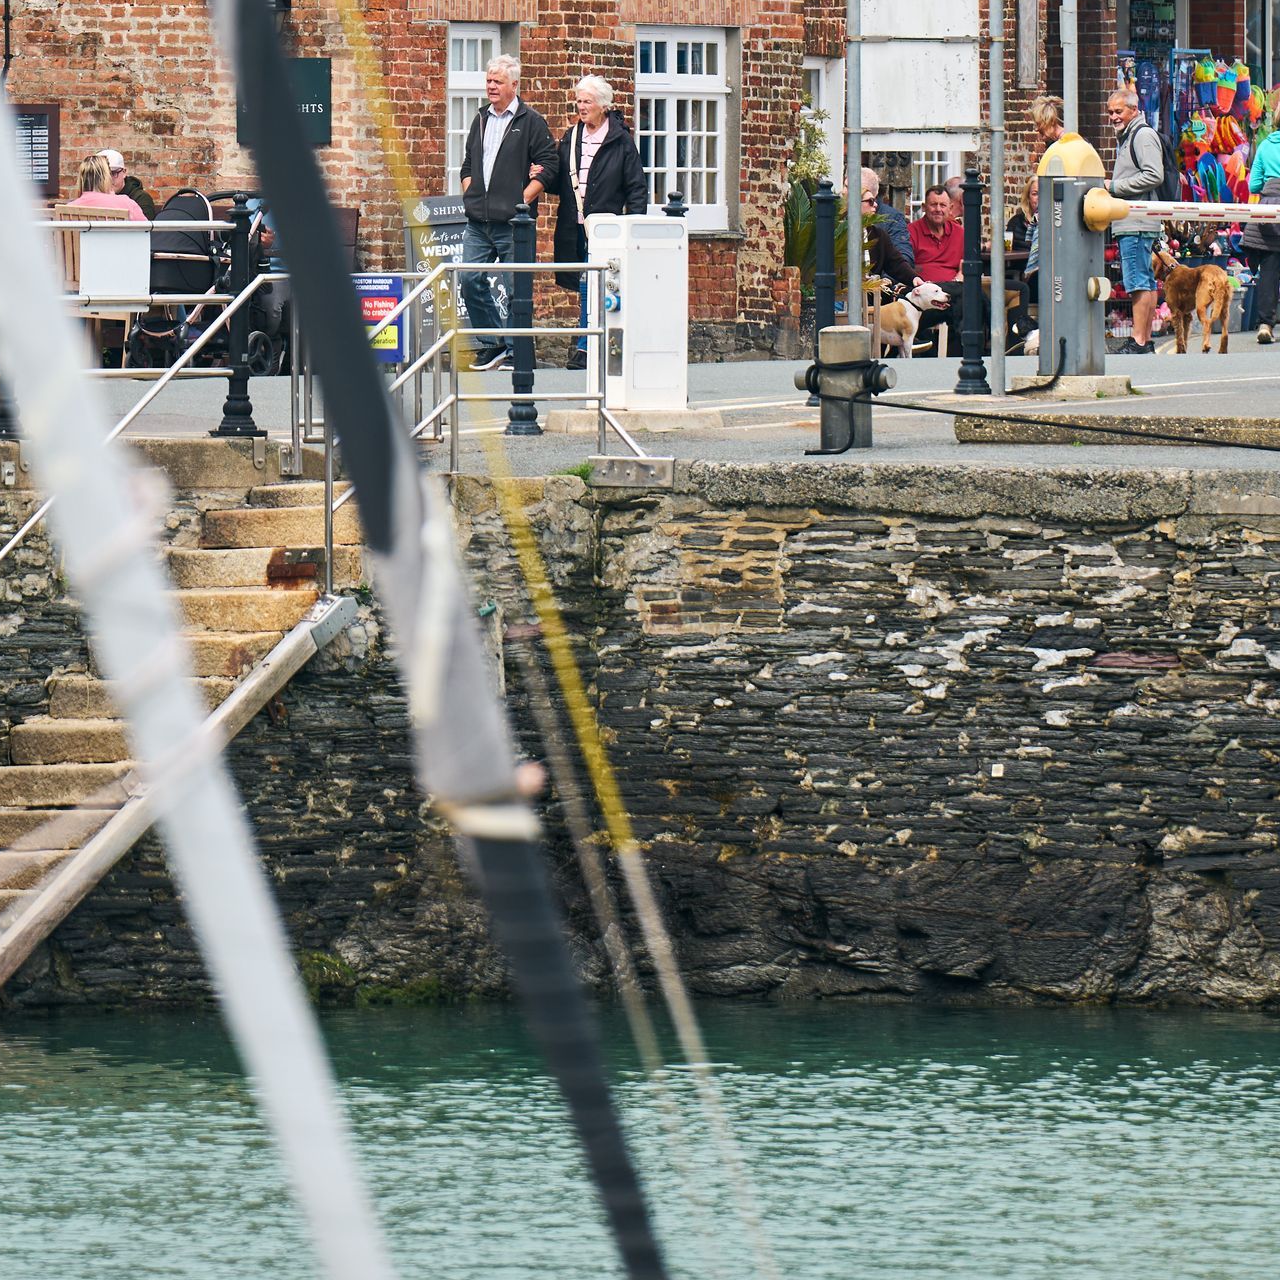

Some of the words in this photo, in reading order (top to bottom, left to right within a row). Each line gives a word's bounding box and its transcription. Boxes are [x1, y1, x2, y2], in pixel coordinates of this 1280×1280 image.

[433, 205, 466, 215] SHIPW
[1054, 201, 1062, 227] CAME
[420, 230, 449, 245] What's
[1054, 276, 1063, 302] CAME
[373, 300, 395, 310] Fishing
[373, 337, 396, 346] peration
